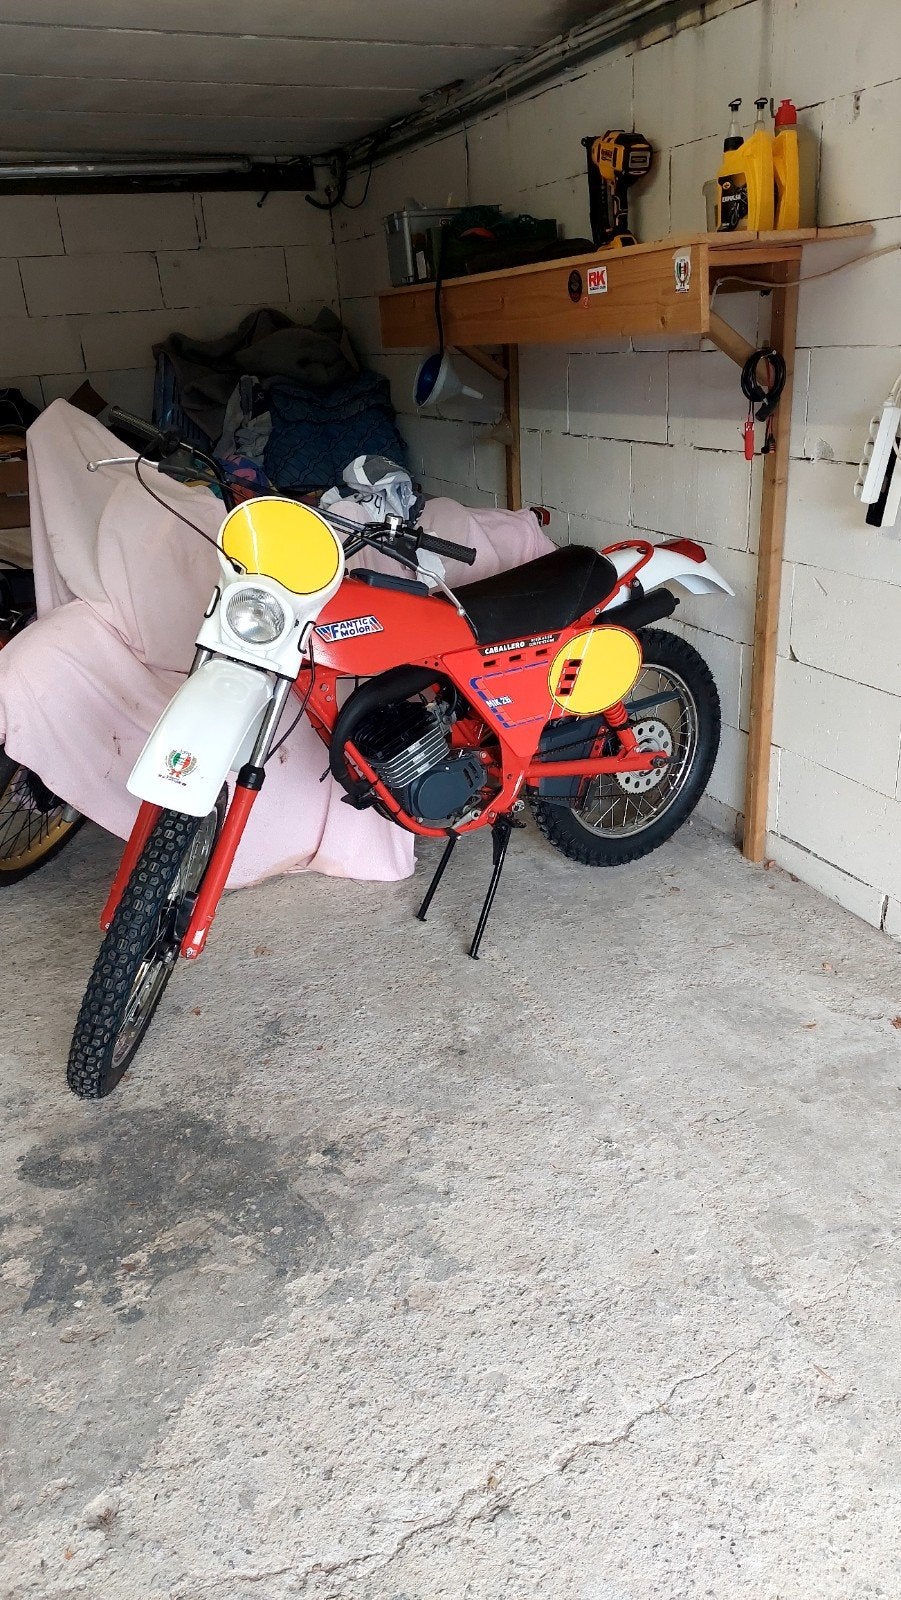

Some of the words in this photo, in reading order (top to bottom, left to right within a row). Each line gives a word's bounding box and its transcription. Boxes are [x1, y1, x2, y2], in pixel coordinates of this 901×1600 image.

[588, 270, 606, 287] RK
[330, 618, 369, 638] FANTIC
[340, 624, 371, 638] MOTOR
[484, 641, 526, 656] CABALLERO
